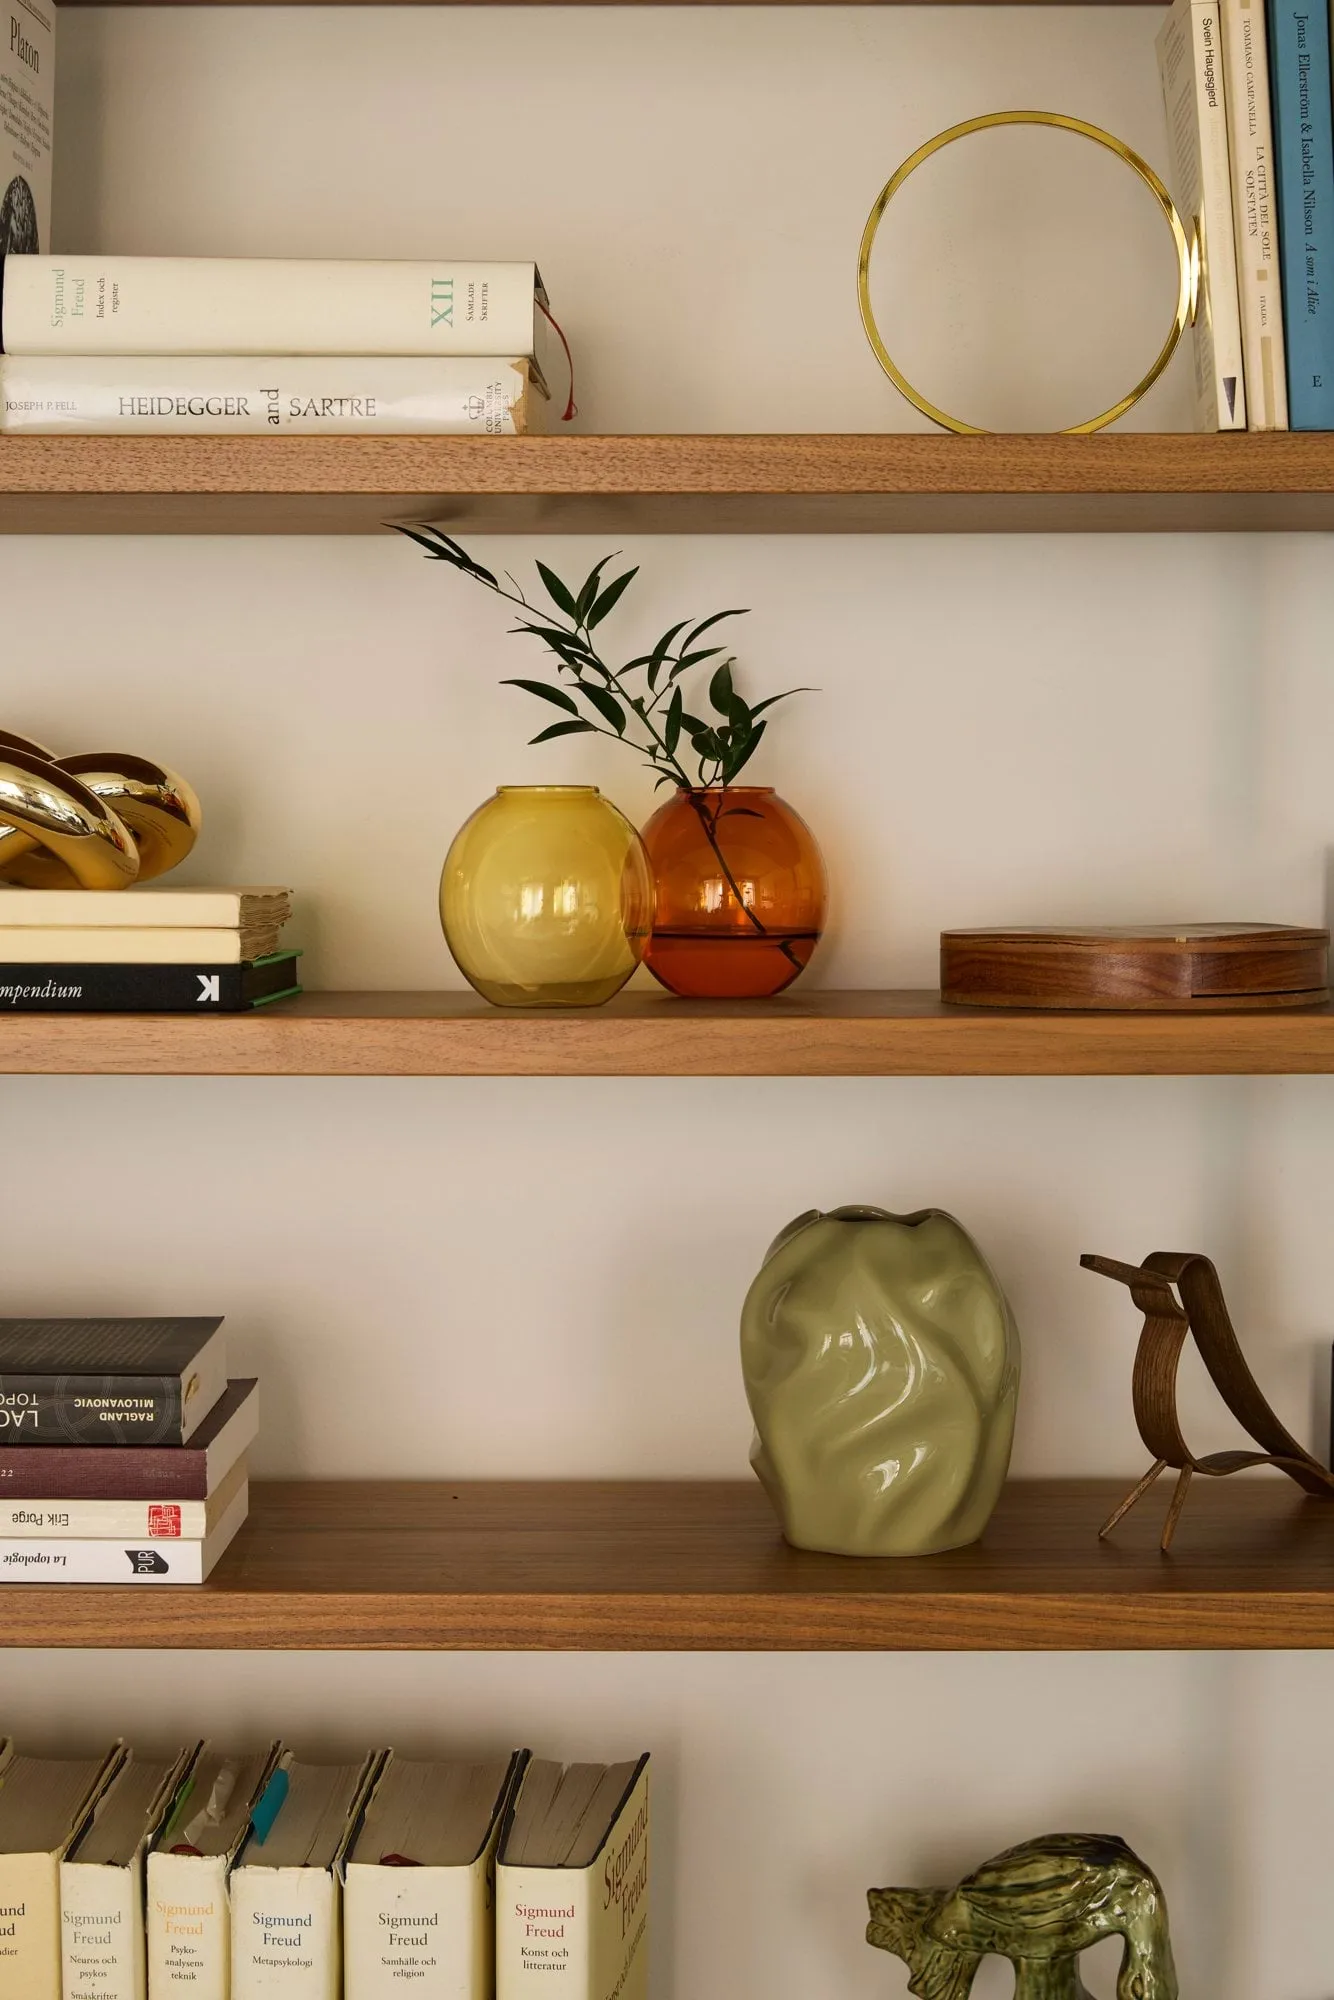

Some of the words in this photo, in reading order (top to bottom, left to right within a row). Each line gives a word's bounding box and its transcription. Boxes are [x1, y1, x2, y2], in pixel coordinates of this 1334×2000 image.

[1202, 18, 1213, 47] Svein
[1294, 12, 1309, 48] Jonas
[10, 16, 39, 74] Platon
[1243, 19, 1253, 69] TOMMASO
[1204, 50, 1219, 107] Haugsgjerd
[1298, 54, 1311, 118] Ellerström
[1246, 72, 1257, 137] CAMPANELLA
[1301, 123, 1313, 133] &
[1257, 146, 1265, 161] LA
[1301, 137, 1315, 185] Isabella
[1258, 163, 1269, 201] CITTÀ
[1246, 170, 1258, 236] SOLSTATEN
[1260, 205, 1269, 227] DEL
[1304, 190, 1316, 235] Nilsson
[1262, 231, 1271, 260] SOLE
[1306, 256, 1315, 277] som
[97, 278, 105, 293] och
[51, 269, 66, 327] Sigmund
[71, 279, 84, 316] Freud
[112, 283, 120, 313] register
[431, 278, 453, 328] XII
[466, 282, 474, 321] SAMLADE
[480, 282, 488, 321] SKRIFTER
[1307, 287, 1320, 315] Alice
[96, 295, 104, 318] Index
[1259, 295, 1267, 326] ITALICA
[1313, 375, 1323, 388] E
[6, 401, 43, 411] JOSEPH
[47, 401, 54, 411] P.
[56, 401, 77, 411] FELL
[119, 397, 250, 416] HEIDEGGER
[260, 388, 280, 425] and
[290, 398, 376, 417] SARTRE
[74, 1398, 154, 1408] MILOVANOVIC
[99, 1412, 154, 1422] RAGLAND
[12, 1511, 43, 1526] Porge
[47, 1513, 69, 1526] Erik
[3, 1553, 50, 1566] topologie
[54, 1555, 67, 1566] La
[138, 1551, 155, 1574] PUR
[604, 1775, 649, 1910] Sigmund
[621, 1838, 648, 1940] Freud
[156, 1901, 214, 1917] Sigmund
[515, 1904, 575, 1920] Sigmund
[63, 1911, 122, 1927] Sigmund
[252, 1912, 312, 1928] Sigmund
[378, 1912, 439, 1929] Sigmund
[165, 1922, 204, 1935] Freud
[525, 1924, 564, 1938] Freud
[73, 1931, 112, 1945] Freud
[263, 1932, 301, 1946] Freud
[388, 1932, 428, 1946] Freud
[171, 1945, 198, 1955] Psyko-
[520, 1947, 549, 1958] Konst
[551, 1947, 569, 1958] och
[70, 1955, 100, 1965] Neuros
[101, 1955, 117, 1965] och
[165, 1958, 204, 1969] analysens
[252, 1955, 313, 1968] Metapsykologi
[381, 1956, 419, 1966] Samhälle
[421, 1956, 437, 1966] och
[523, 1959, 567, 1971] litteratur
[79, 1969, 108, 1980] psykos
[171, 1971, 197, 1981] teknik
[393, 1969, 425, 1979] religion
